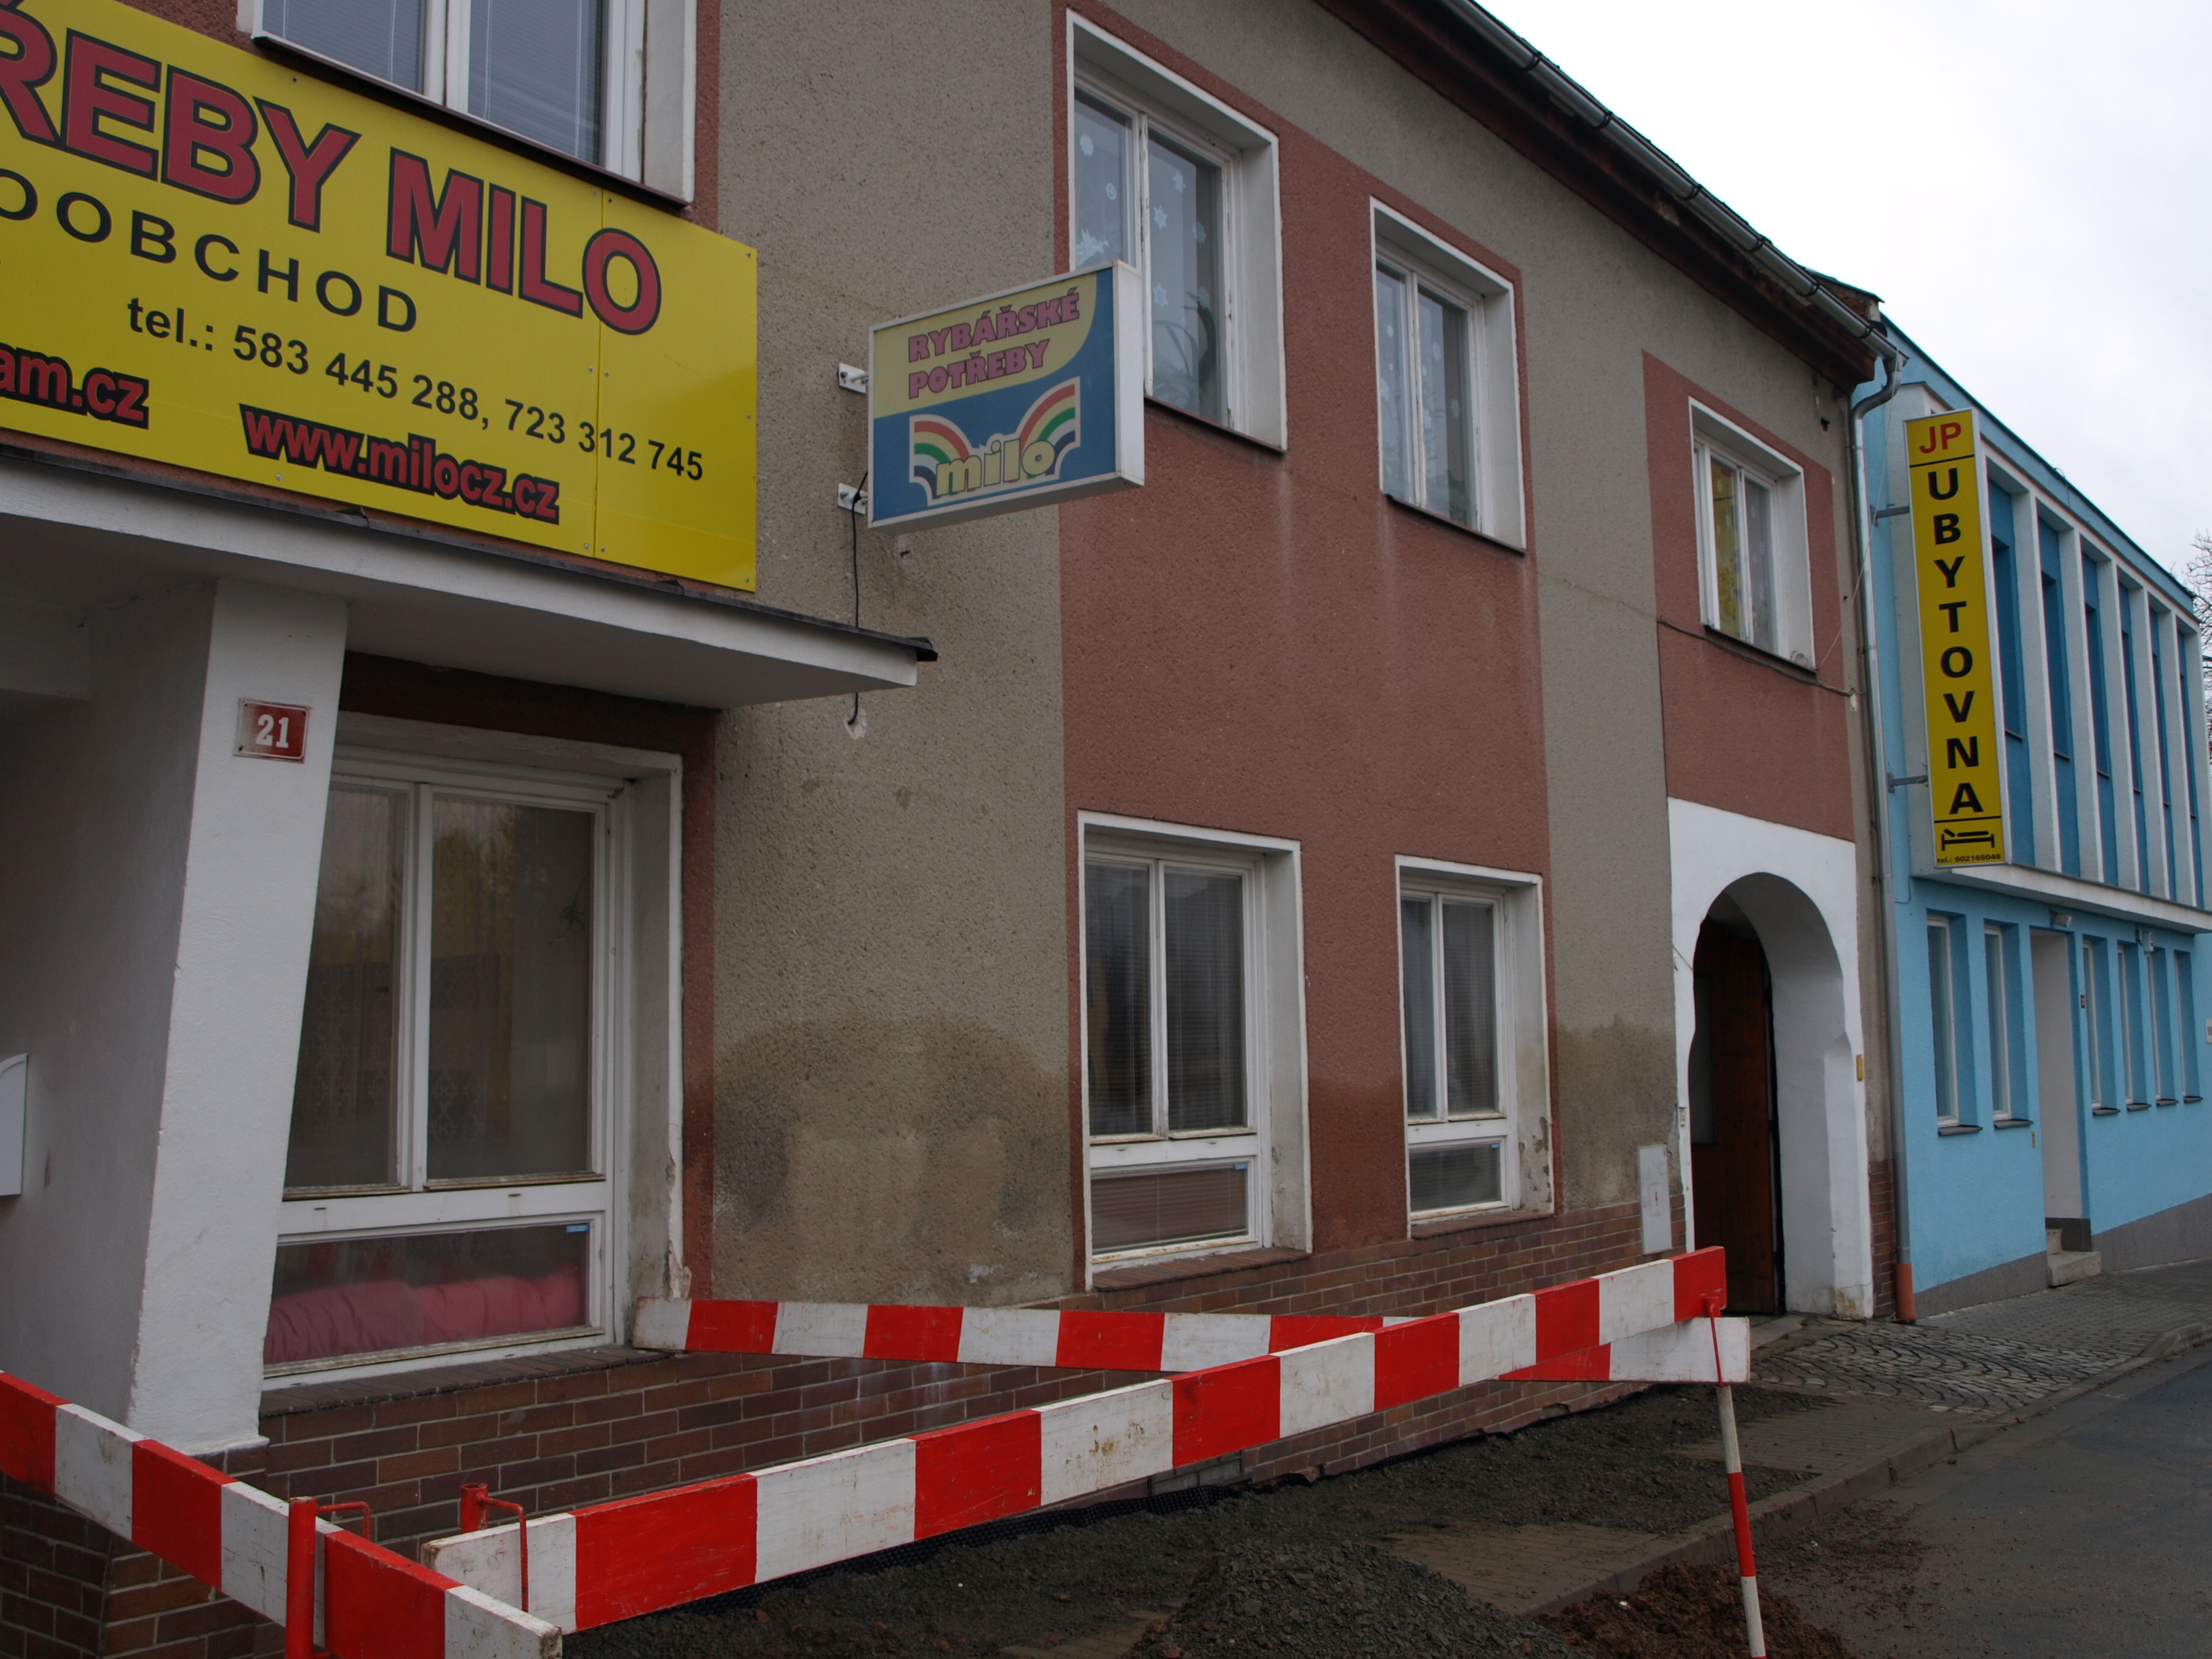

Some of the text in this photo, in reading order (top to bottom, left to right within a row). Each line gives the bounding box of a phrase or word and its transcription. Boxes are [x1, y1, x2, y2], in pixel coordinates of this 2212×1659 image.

[386, 147, 662, 335] MILO
[909, 287, 1080, 363] RYBÁŘSKÉ
[127, 298, 703, 481] tel.: 583 445 288, 723 312 745
[909, 338, 1051, 399] POTŘEBY
[239, 403, 560, 526] www.milocz.cz
[935, 438, 1055, 497] milo
[1919, 422, 1962, 454] JP
[1928, 468, 1983, 814] UBYTOVNA
[255, 714, 289, 748] 21
[1955, 853, 2001, 862] 602165046
